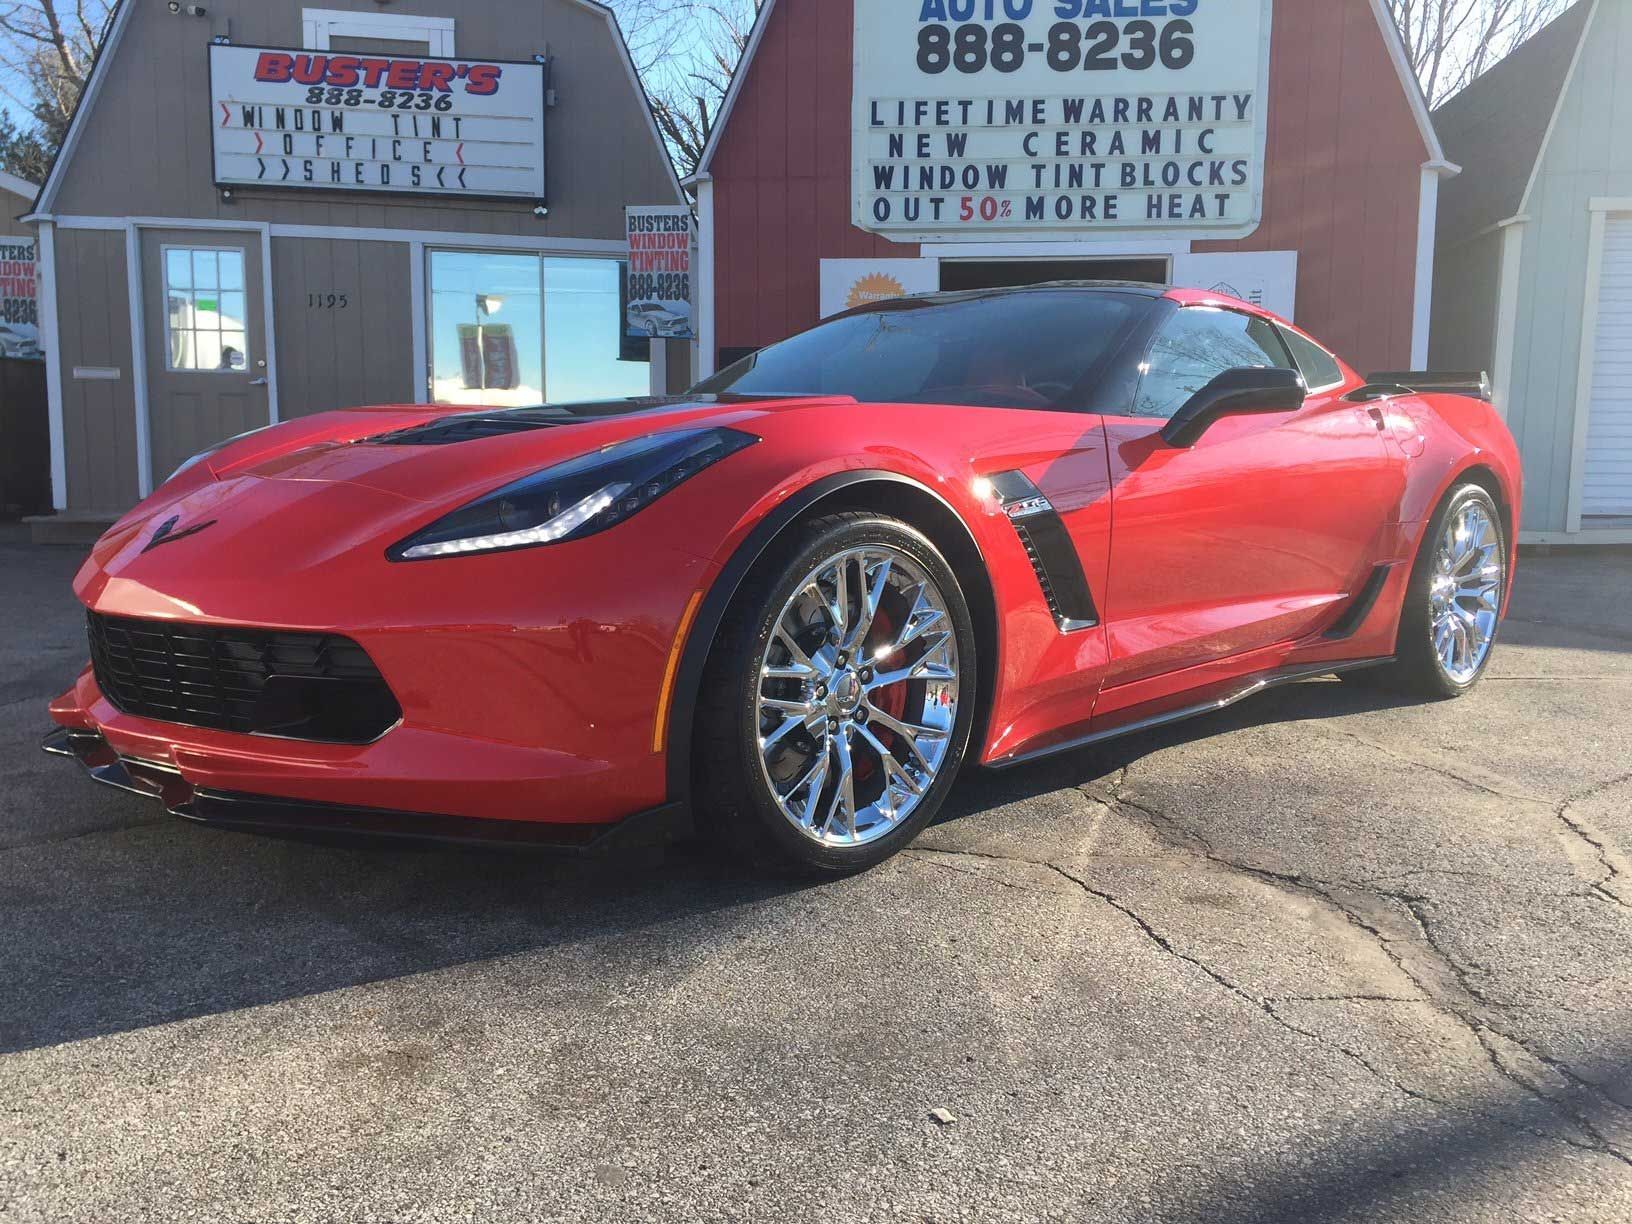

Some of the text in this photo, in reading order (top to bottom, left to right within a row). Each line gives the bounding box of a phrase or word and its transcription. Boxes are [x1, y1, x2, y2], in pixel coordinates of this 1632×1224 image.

[916, 19, 1195, 74] 888-8236
[253, 51, 503, 96] BUSTER'S
[305, 86, 454, 112] 888-8236
[870, 94, 1252, 127] LIFETIME WARRANTY
[241, 105, 462, 139] WINDOW TINT
[283, 133, 433, 163] OFFICE
[888, 128, 1215, 158] NEW CERAMIC
[873, 160, 1248, 191] WINDOW TINT BLOCKS
[873, 193, 1230, 222] OUT 50% MORE HEAT
[628, 214, 689, 232] BUSTERS
[628, 233, 689, 250] WINDOW
[628, 250, 689, 273] TINTING
[308, 293, 348, 309] 1195
[629, 272, 690, 301] 888-8236
